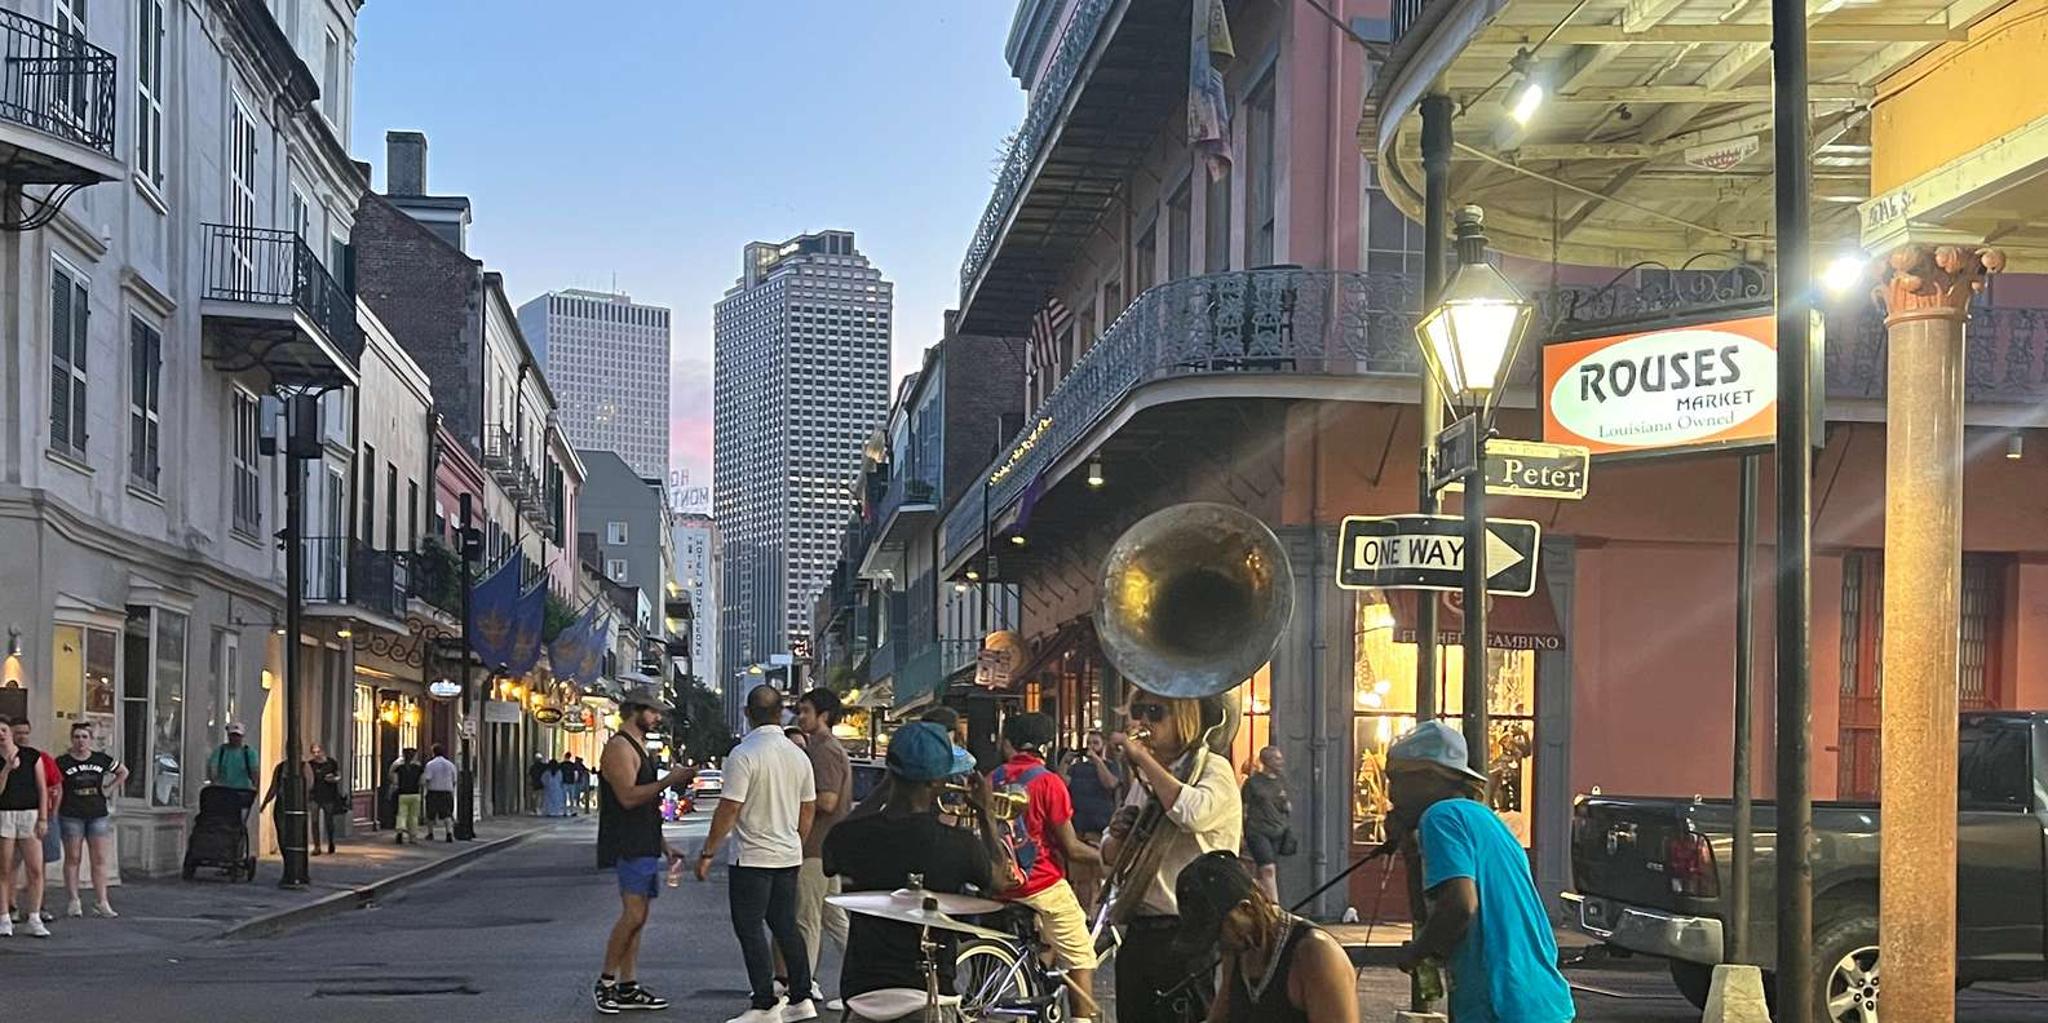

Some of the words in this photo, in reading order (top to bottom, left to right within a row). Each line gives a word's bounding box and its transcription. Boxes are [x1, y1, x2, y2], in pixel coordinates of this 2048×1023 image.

[1580, 345, 1741, 403] ROUSES
[1677, 389, 1756, 412] MARKET
[1599, 421, 1673, 438] Louisiana
[1677, 410, 1735, 431] Owned
[1503, 459, 1581, 488] Peter
[695, 540, 703, 577] HOTEL
[1363, 539, 1401, 566] ONE
[1409, 538, 1465, 567] WAY
